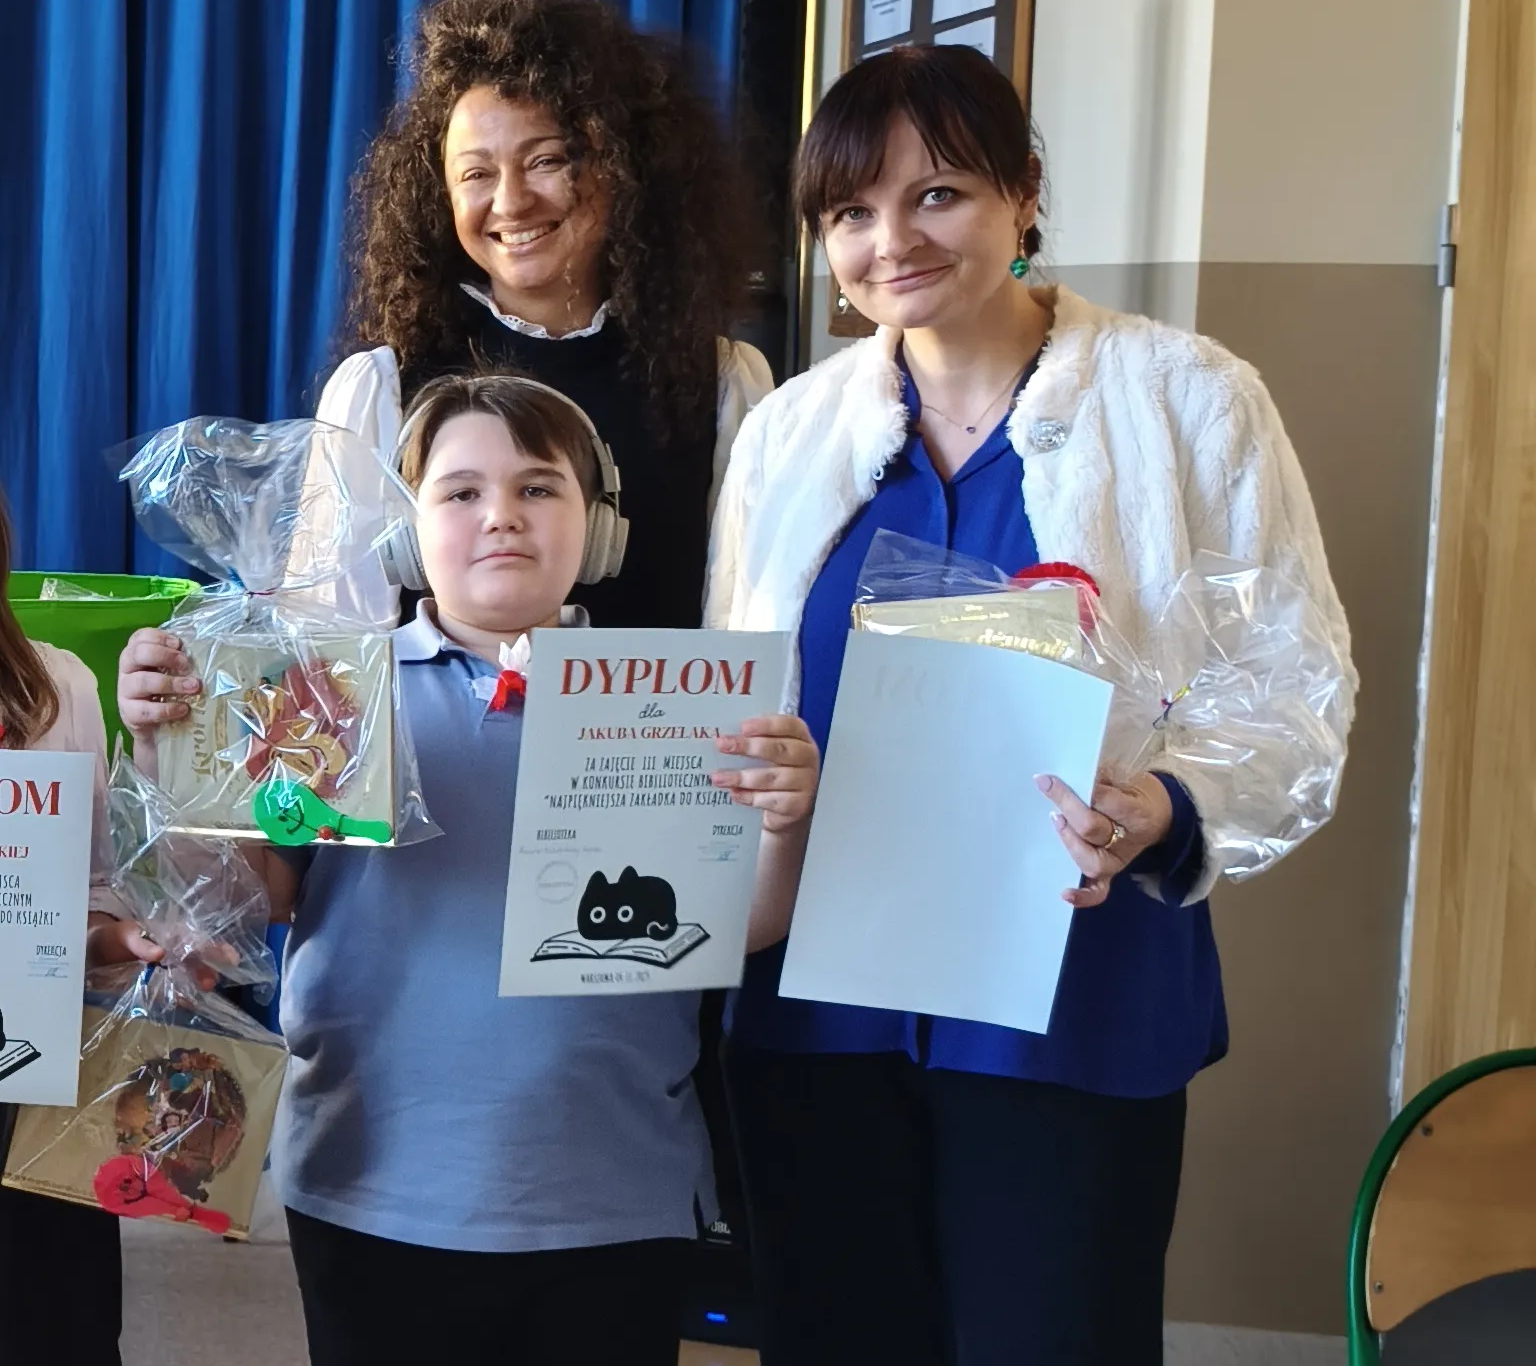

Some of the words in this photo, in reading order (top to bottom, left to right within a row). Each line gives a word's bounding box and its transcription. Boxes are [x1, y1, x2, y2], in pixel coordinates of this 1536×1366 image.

[560, 657, 757, 696] DYPLOM
[638, 702, 666, 719] dla
[576, 726, 637, 741] JAKUBA
[640, 726, 721, 740] GRZELAKA
[585, 756, 596, 772] ZA
[599, 756, 636, 773] ZAJĘCIE
[642, 755, 656, 771] III
[663, 755, 703, 771] MIEJSCA
[570, 776, 580, 790] W
[582, 775, 635, 790] KONKURSIE
[629, 791, 676, 807] ZAKŁADKA
[679, 791, 692, 806] DO
[0, 911, 13, 924] DO
